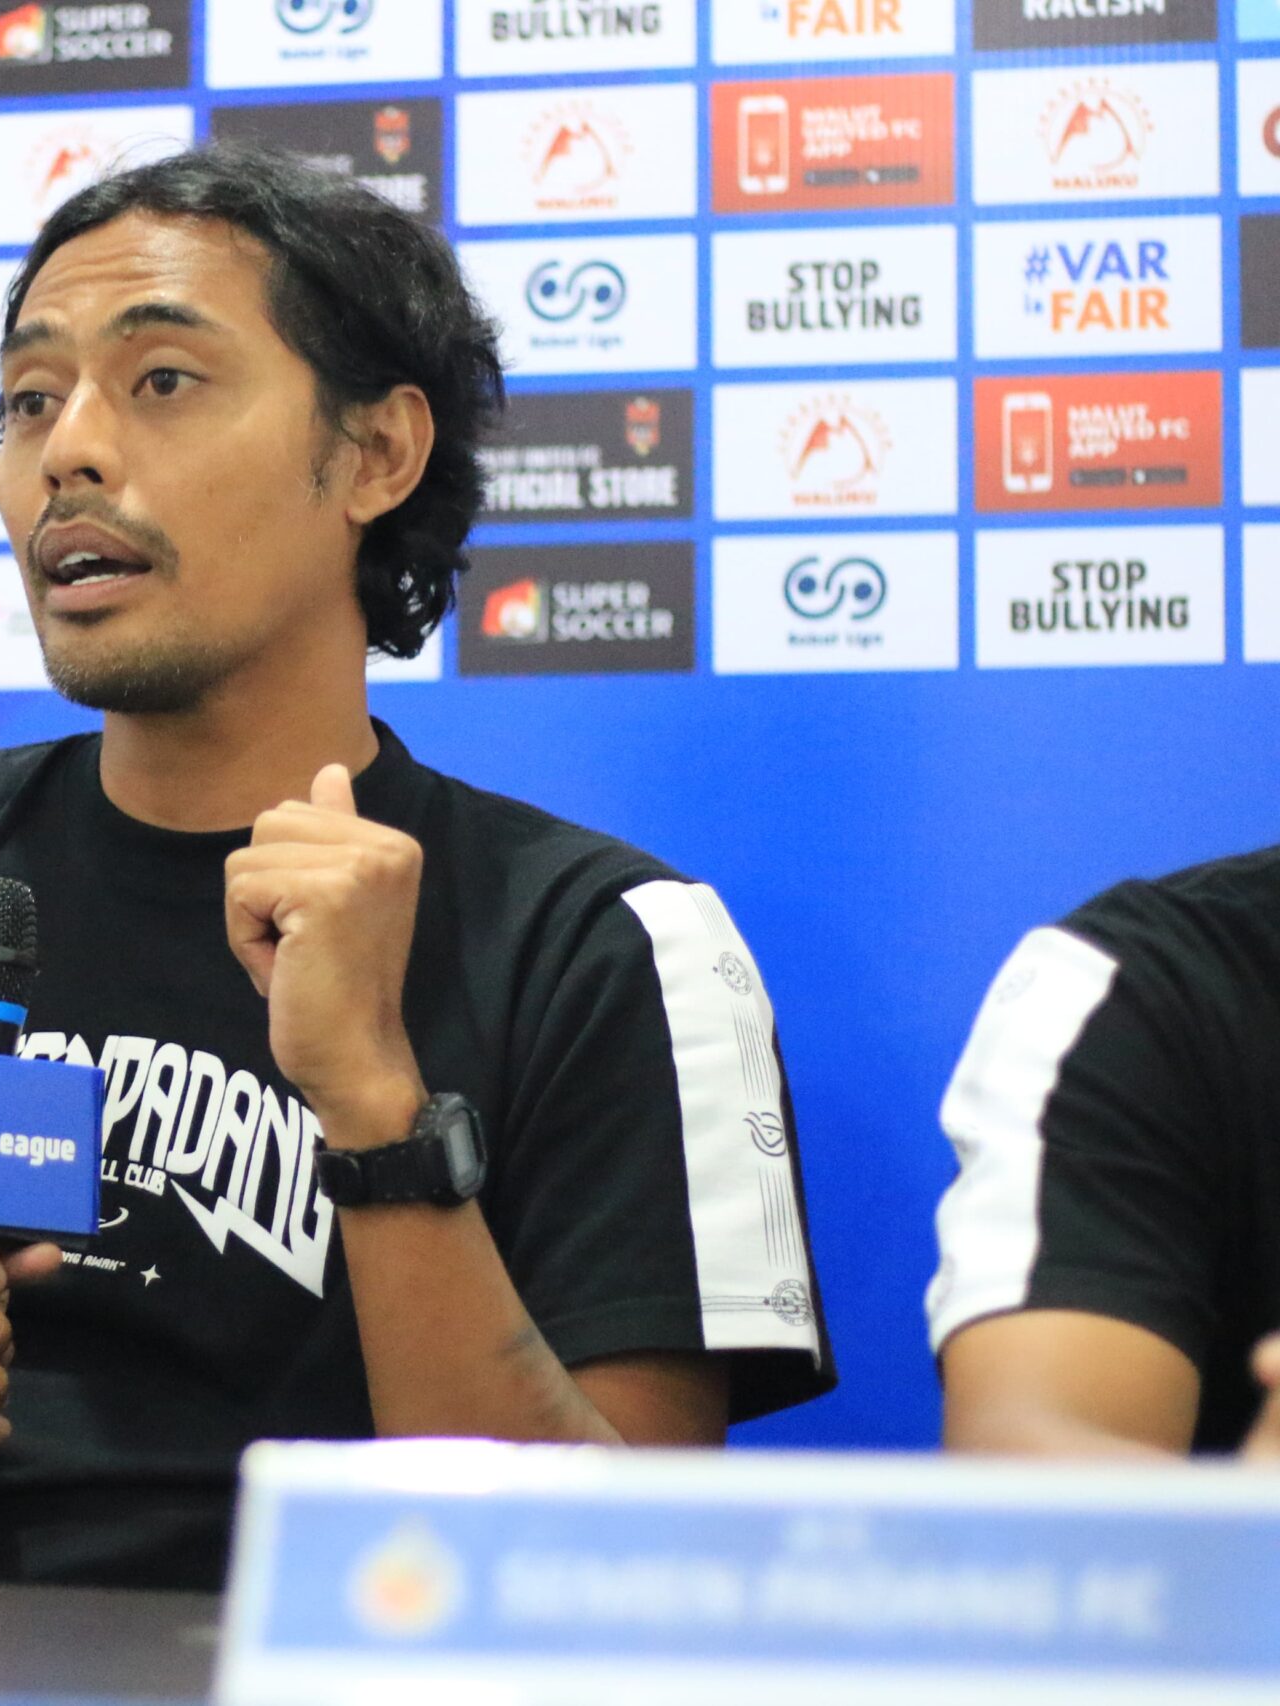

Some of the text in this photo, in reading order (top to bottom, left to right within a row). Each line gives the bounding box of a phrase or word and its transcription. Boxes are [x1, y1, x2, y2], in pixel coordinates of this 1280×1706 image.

[55, 4, 150, 31] SUPER
[491, 4, 660, 41] BULLYING
[787, 0, 903, 37] FAIR
[54, 29, 172, 61] SOCCER
[788, 260, 880, 294] STOP
[1024, 240, 1169, 283] #VAR
[746, 295, 922, 332] BULLYING
[1051, 288, 1170, 332] FAIR
[589, 465, 678, 508] STORE
[1052, 560, 1147, 594] STOP
[553, 582, 650, 611] SUPER
[1010, 596, 1190, 632] BULLYING
[553, 608, 674, 641] SOCCER
[124, 1162, 167, 1196] CLUB
